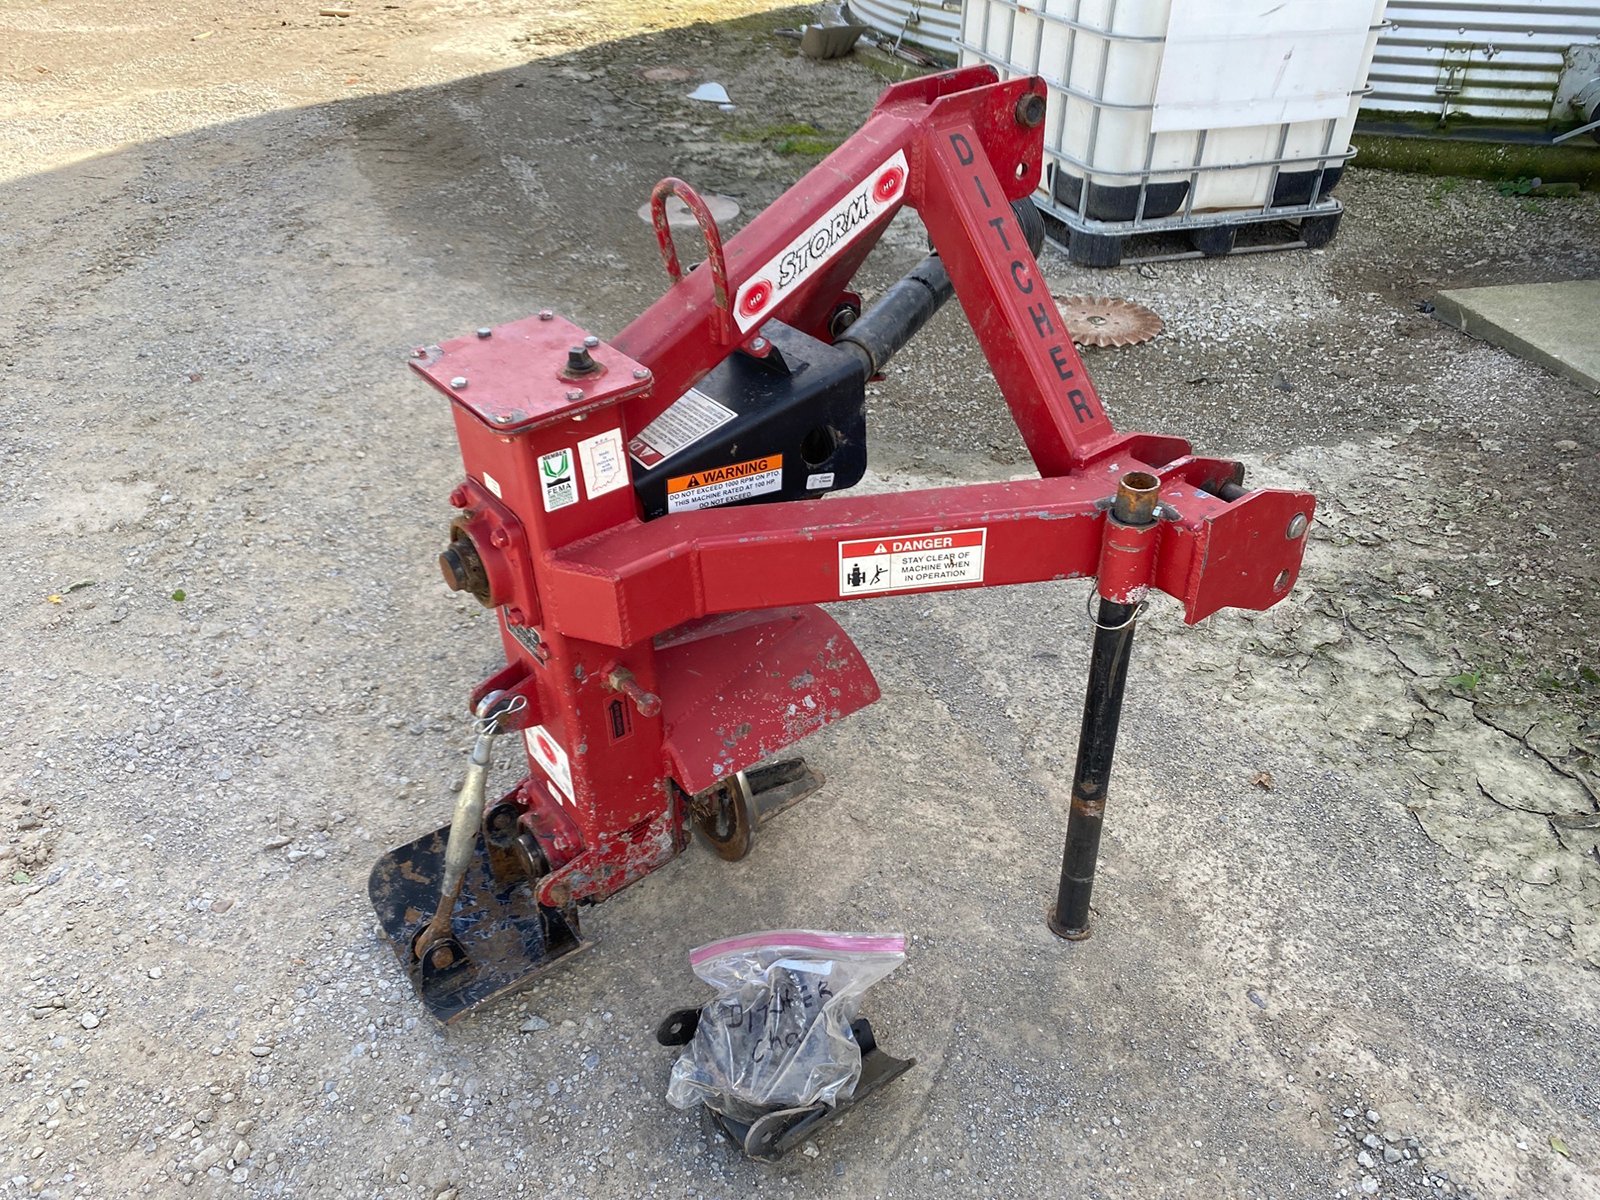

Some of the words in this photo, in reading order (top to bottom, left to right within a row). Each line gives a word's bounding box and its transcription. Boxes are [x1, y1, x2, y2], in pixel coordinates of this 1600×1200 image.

[750, 293, 762, 306] HD
[778, 187, 870, 289] STORM
[882, 179, 894, 191] HD
[949, 133, 1093, 423] DITCHER
[543, 450, 567, 460] MEMBER
[703, 460, 768, 483] WARNING
[547, 483, 571, 495] FEMA
[670, 493, 679, 501] DO
[681, 490, 695, 499] NOT
[697, 484, 723, 495] EXCEED
[725, 480, 739, 488] 1000
[740, 477, 754, 485] RPM
[756, 474, 765, 482] ON
[766, 471, 780, 479] PTO.
[675, 499, 690, 507] THIS
[692, 492, 721, 504] MACHINE
[723, 487, 744, 497] RATED
[711, 498, 724, 507] NOT
[893, 538, 952, 552] DANGER
[926, 554, 956, 562] CLEAR
[901, 563, 942, 573] MACHINE
[944, 561, 970, 569] WHEN
[916, 570, 965, 580] OPERATION
